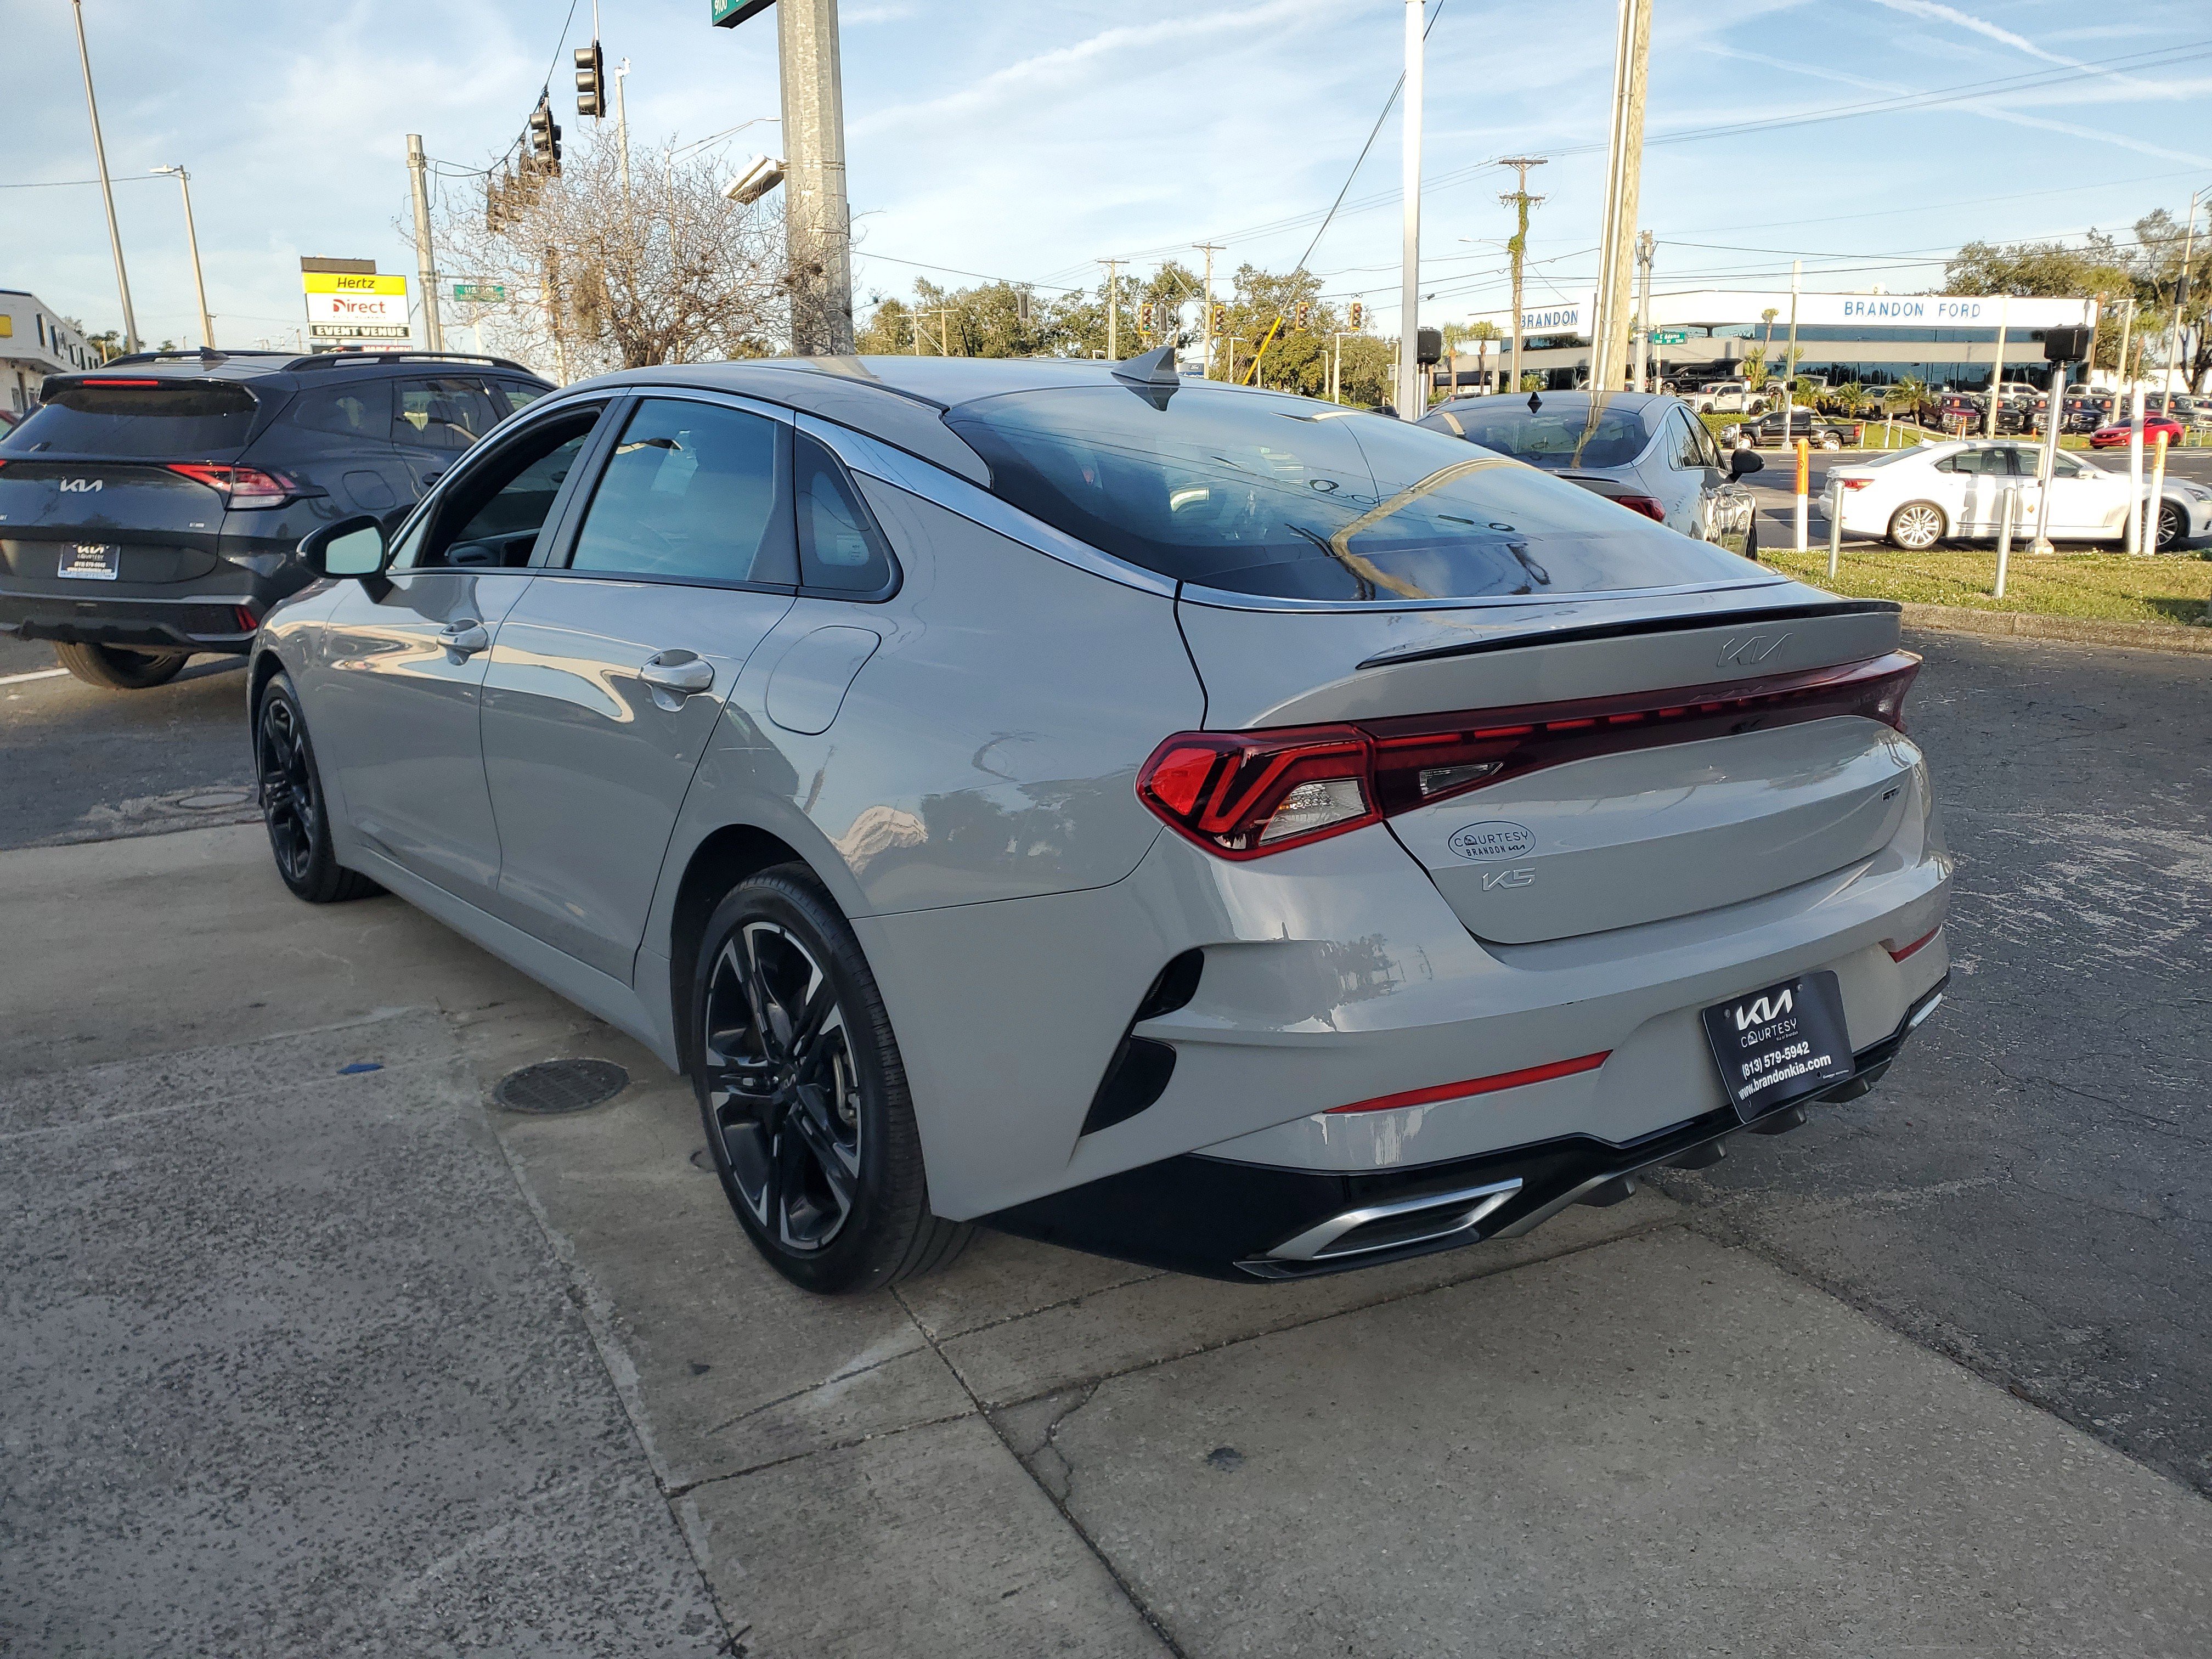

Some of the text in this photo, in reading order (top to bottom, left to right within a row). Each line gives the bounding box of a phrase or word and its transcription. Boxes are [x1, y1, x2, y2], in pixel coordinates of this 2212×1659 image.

[337, 277, 375, 289] Hertz
[333, 299, 386, 313] Direct
[1844, 301, 1980, 317] BRANDON FORD
[1521, 310, 1578, 328] BRANDON
[316, 326, 405, 337] EVENT VENUE
[60, 478, 103, 493] KIA
[1717, 633, 1793, 668] KIA
[1454, 831, 1528, 847] COURTESY
[1466, 845, 1506, 856] BRANDON
[1482, 867, 1536, 891] K5
[1736, 989, 1793, 1031] KIA
[1741, 1017, 1797, 1048] COURTESY
[1742, 1041, 1810, 1080] (813) 579-5942
[1738, 1054, 1832, 1101] www.brandonkia.com
